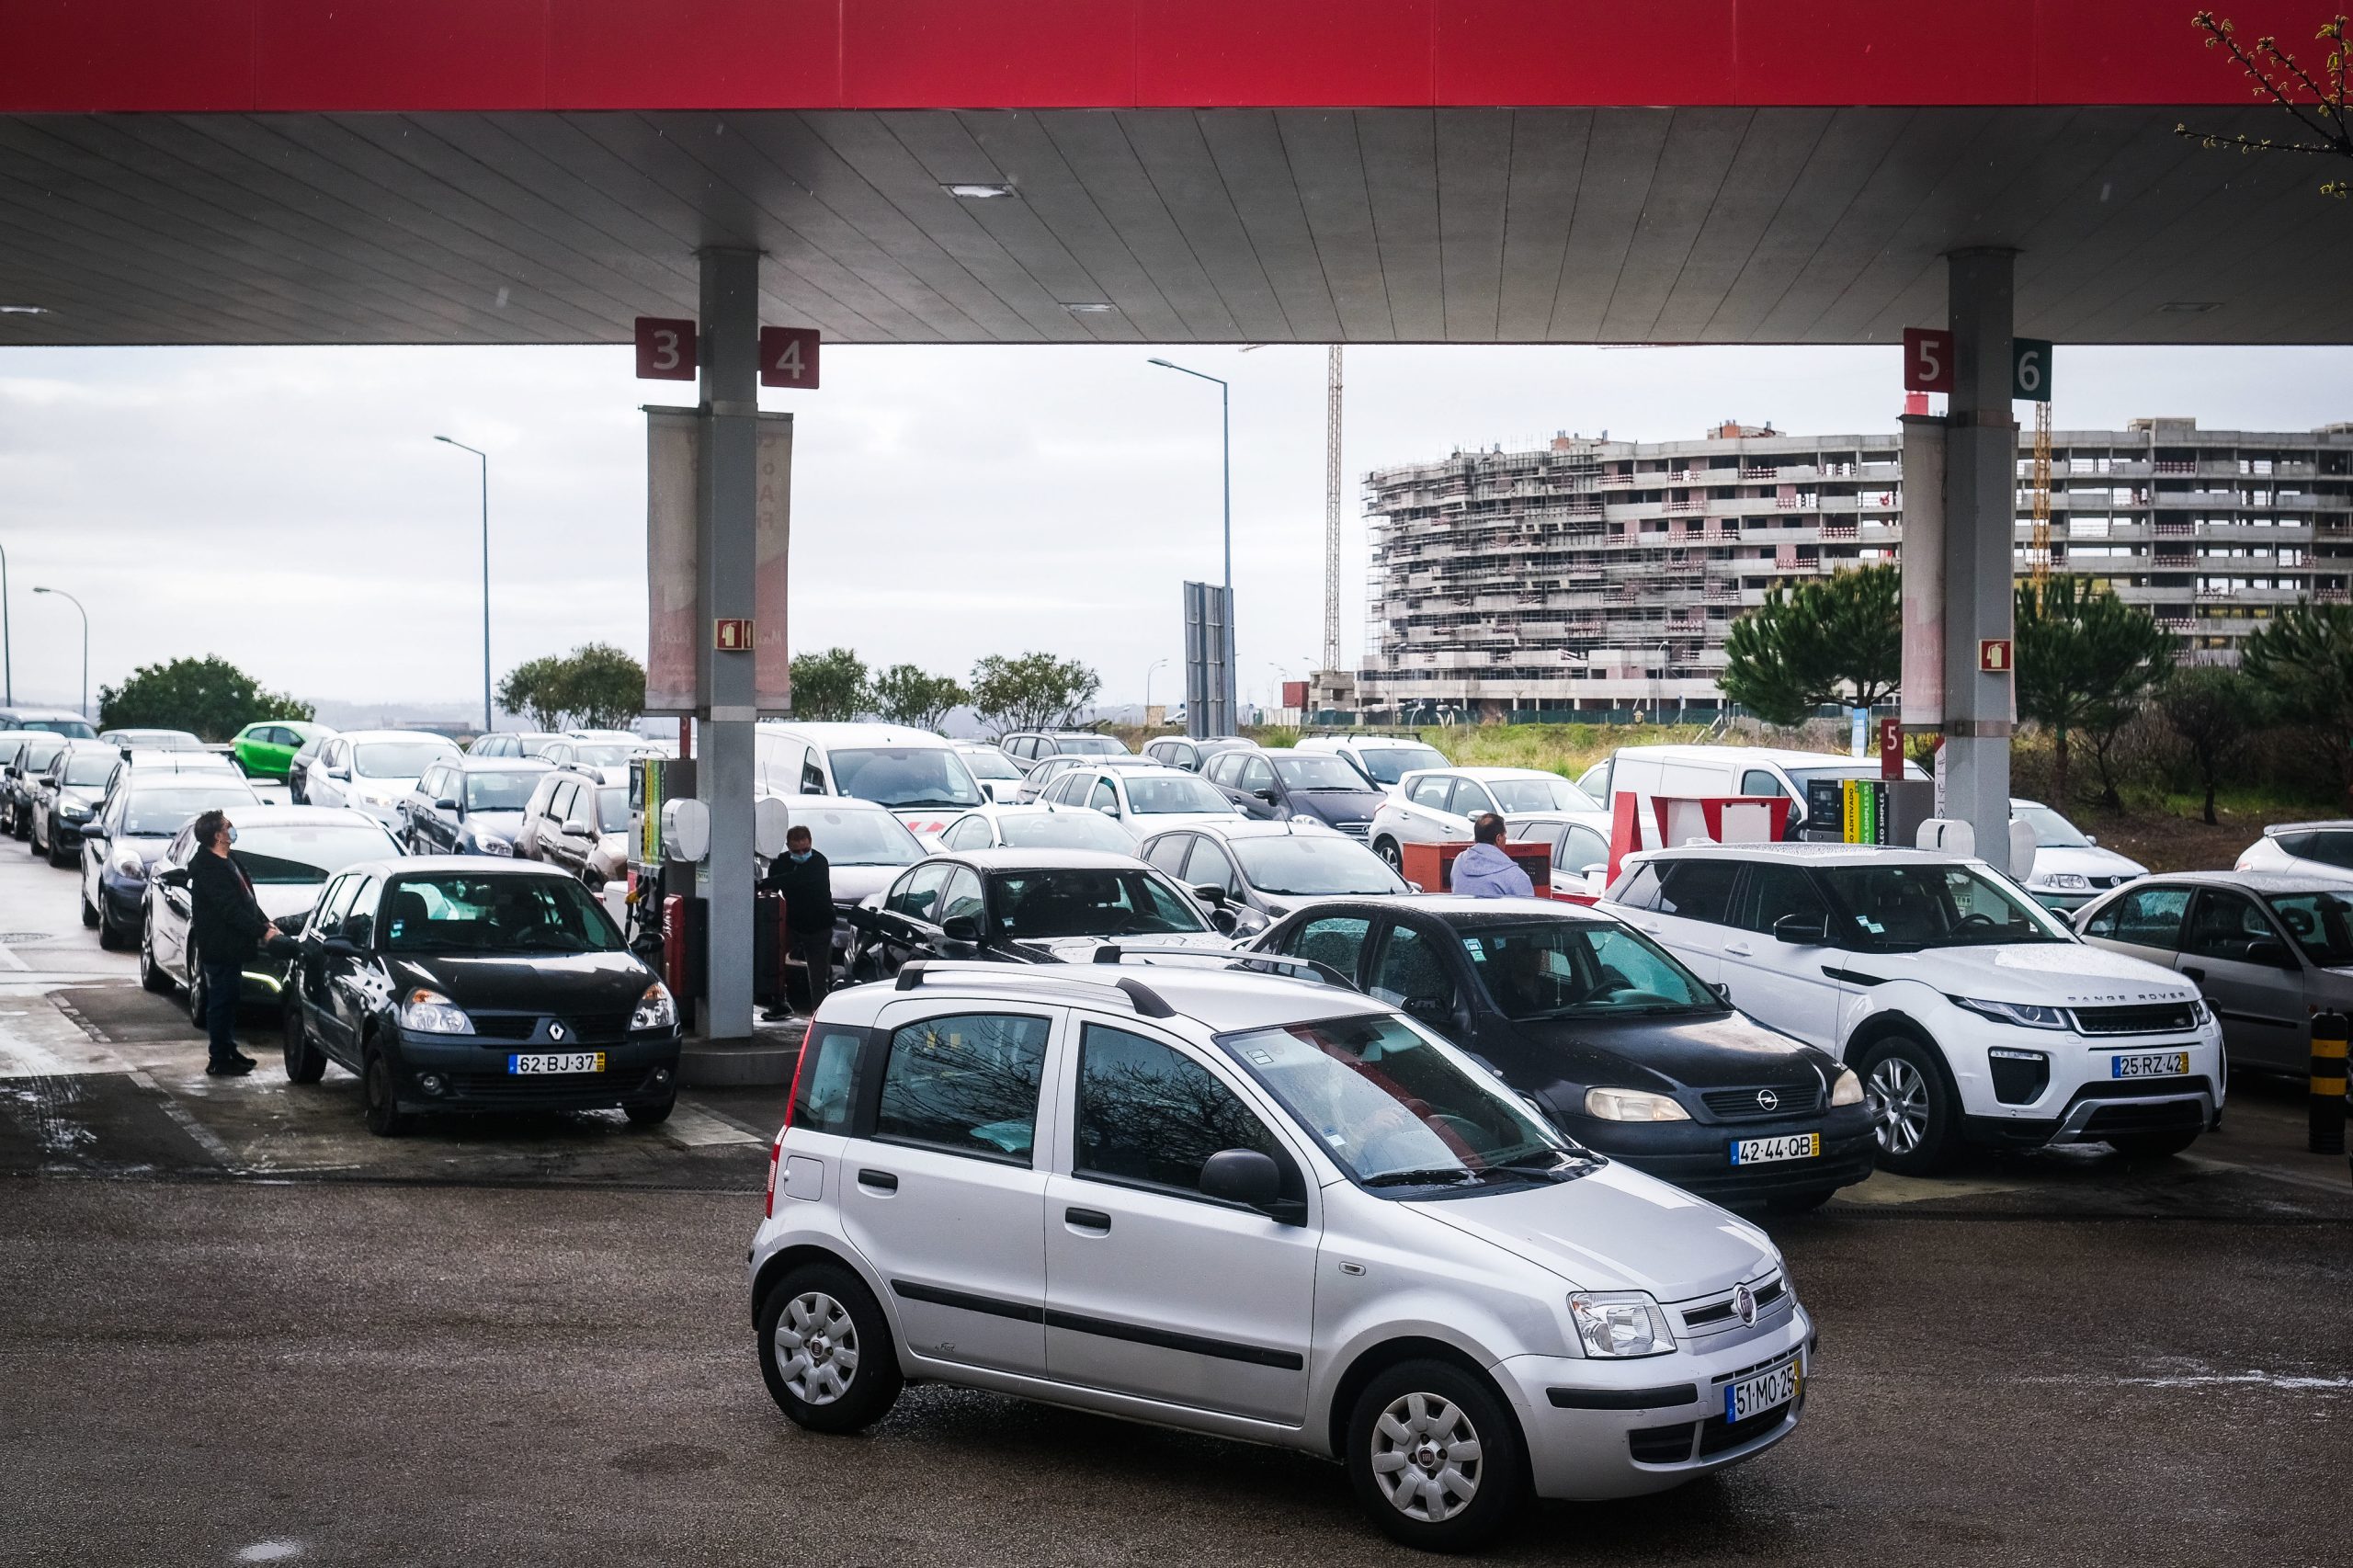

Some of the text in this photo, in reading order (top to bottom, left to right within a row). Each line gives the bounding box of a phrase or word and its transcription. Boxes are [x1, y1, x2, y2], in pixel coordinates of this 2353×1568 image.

[653, 329, 680, 369] 3
[776, 340, 805, 380] 4
[1918, 339, 1939, 381] 5
[2018, 350, 2040, 392] 6
[1887, 725, 1898, 750] 5
[2138, 992, 2187, 1001] ROVER
